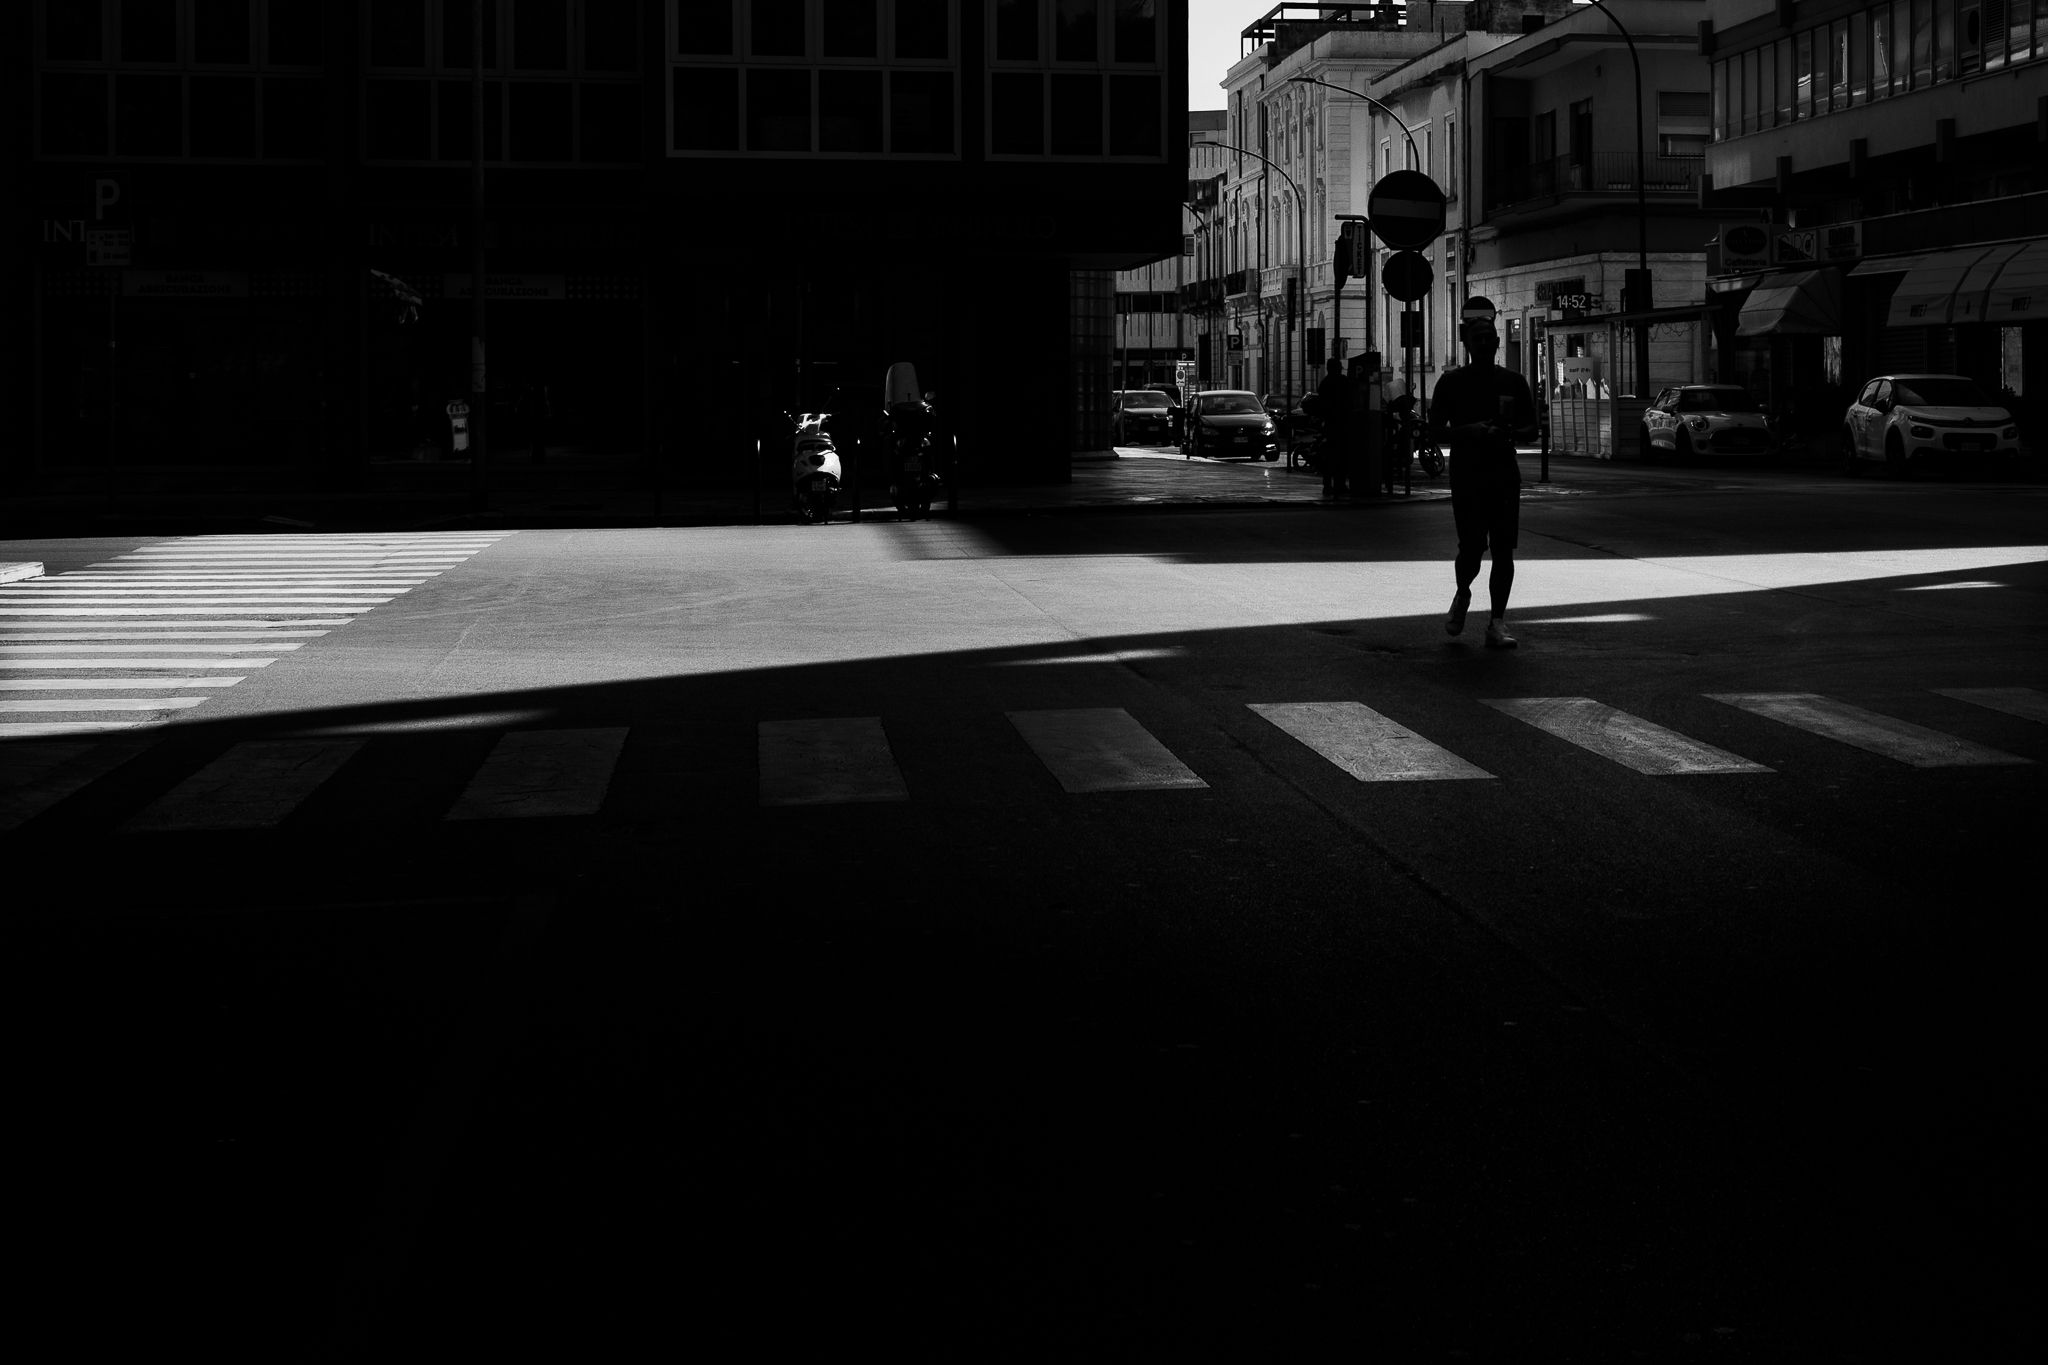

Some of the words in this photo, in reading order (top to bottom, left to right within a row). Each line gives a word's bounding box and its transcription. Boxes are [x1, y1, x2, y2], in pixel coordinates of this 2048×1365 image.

[96, 178, 120, 221] P
[1725, 258, 1767, 267] Caffetteria
[166, 274, 206, 284] BANCA
[486, 277, 523, 287] BANCA
[139, 285, 232, 295] ASSICURAZIONE
[459, 287, 549, 298] ASCURAZIONE
[1556, 294, 1586, 309] 14:52
[1231, 336, 1240, 349] P
[1356, 365, 1363, 379] P
